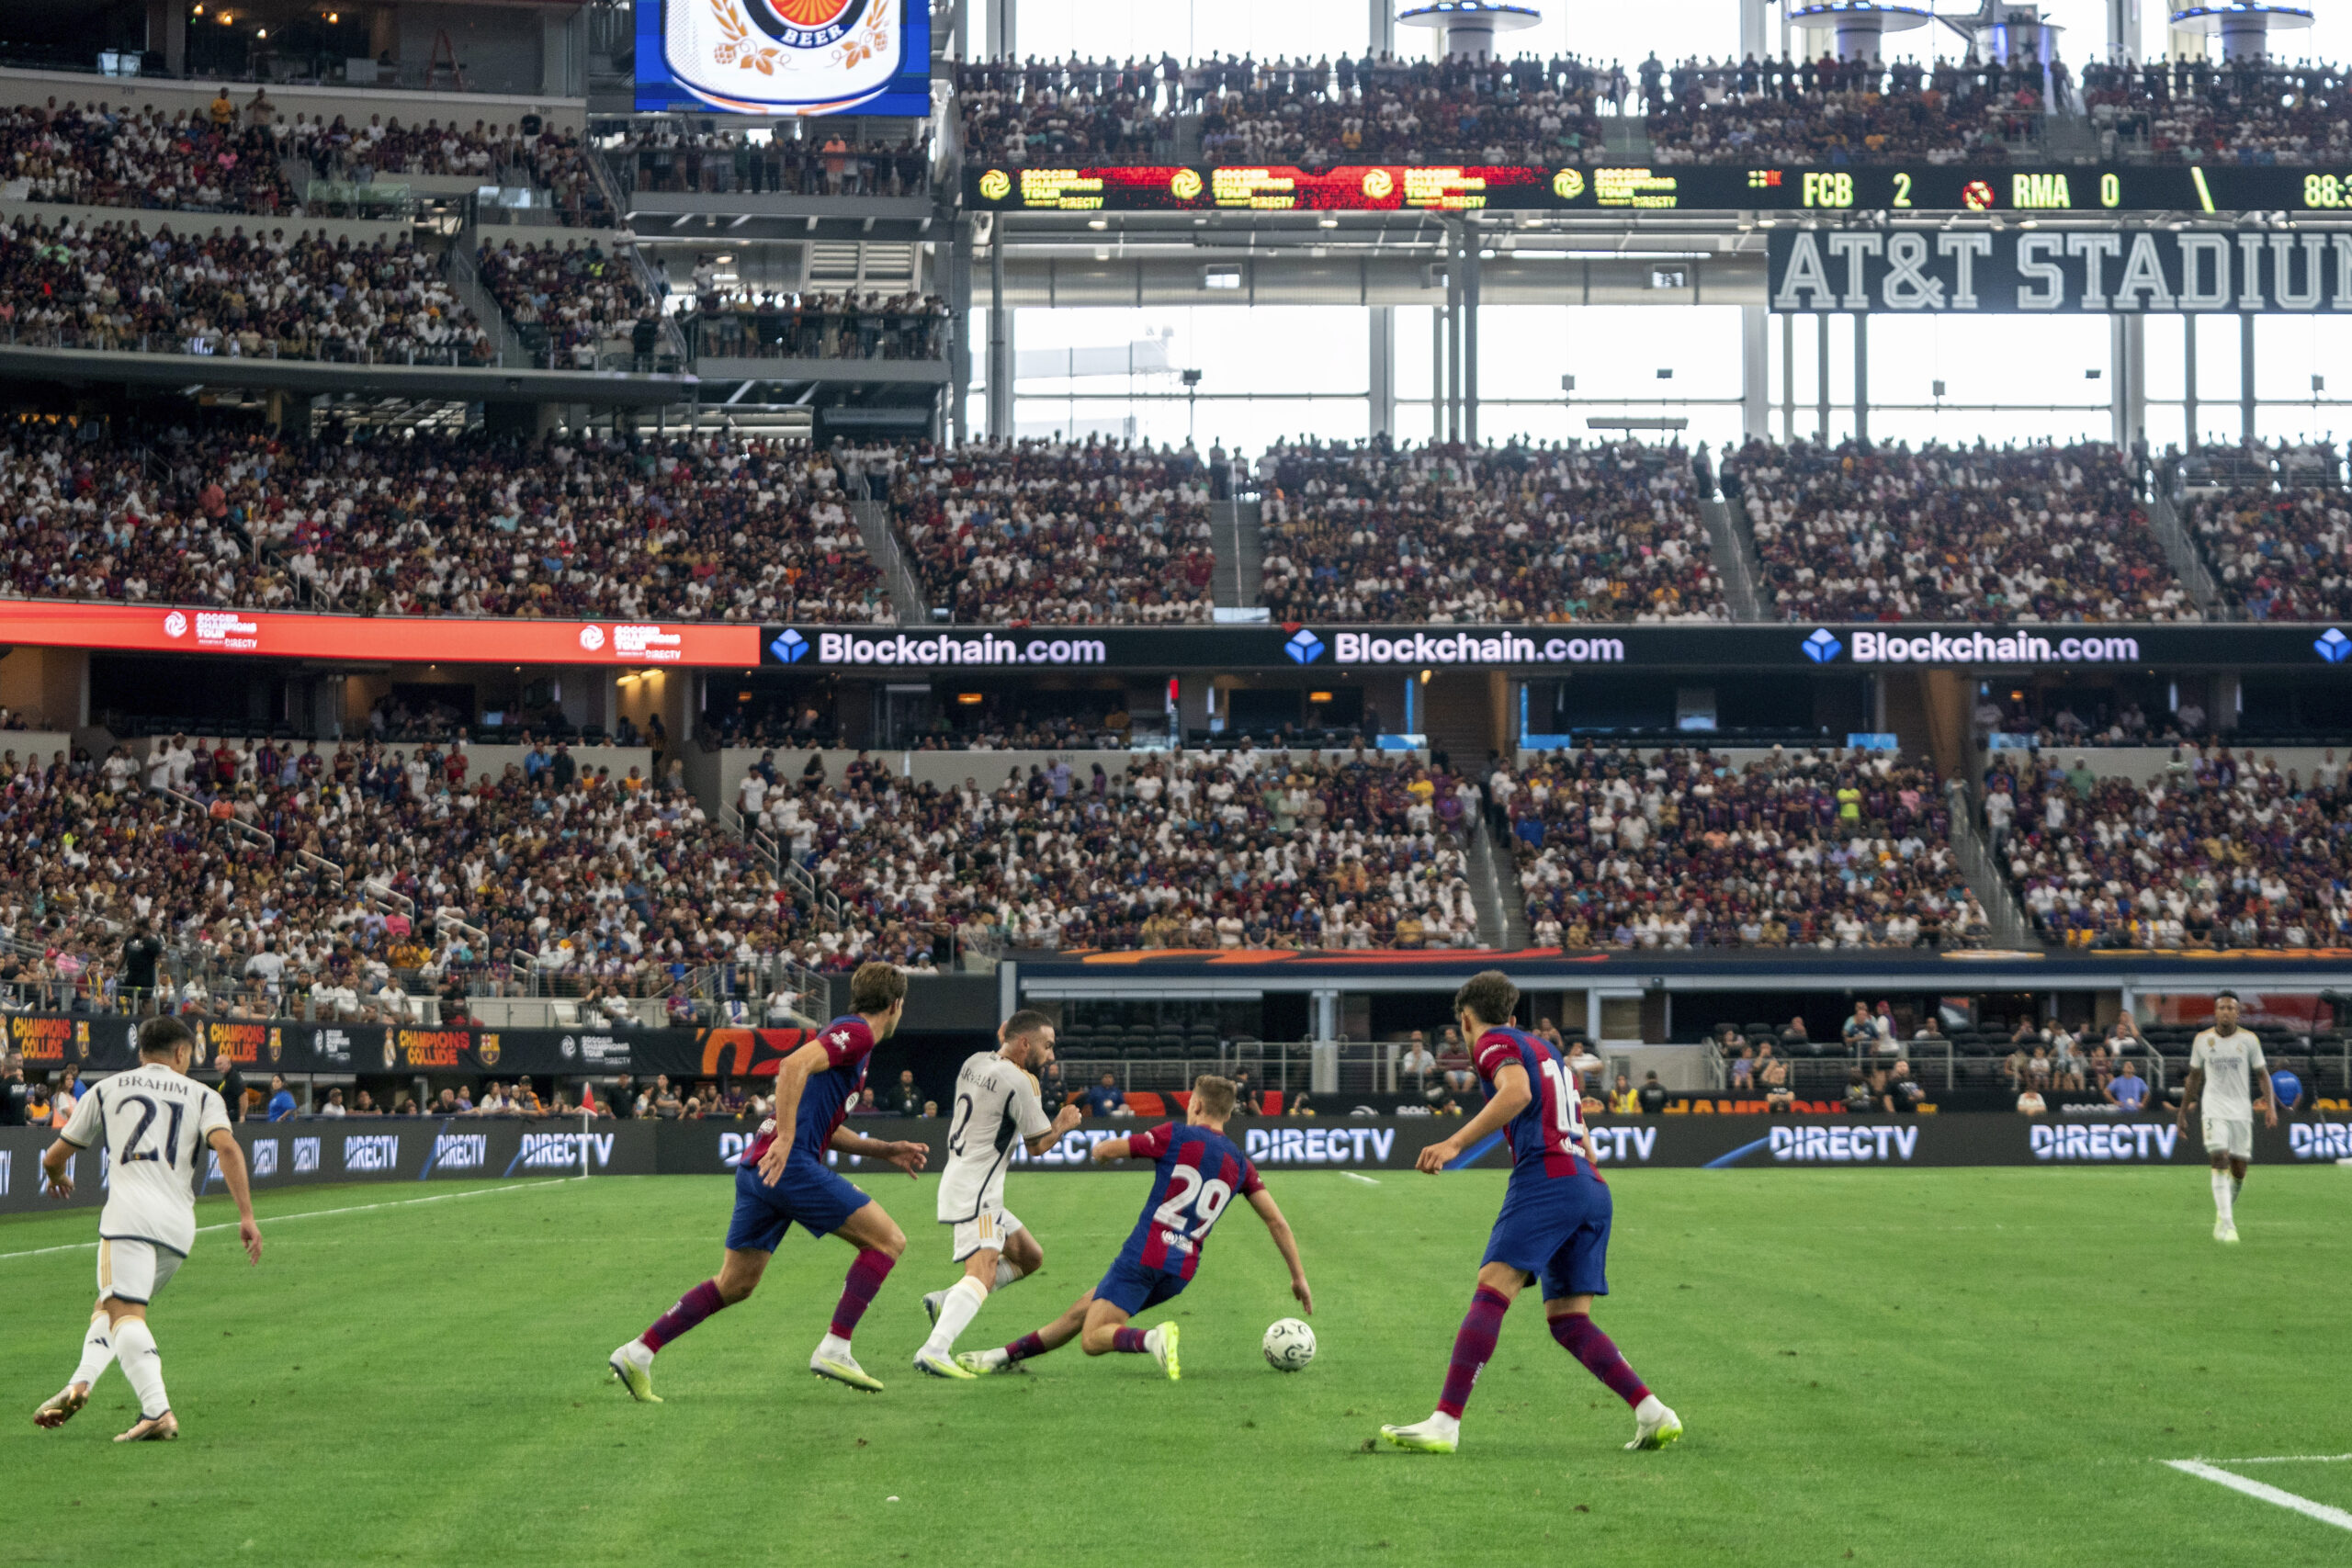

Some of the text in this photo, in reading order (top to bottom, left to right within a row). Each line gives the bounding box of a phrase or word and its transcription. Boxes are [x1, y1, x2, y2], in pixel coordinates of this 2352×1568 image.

[780, 24, 844, 47] BEER
[1021, 169, 1078, 180] SOCCER
[1212, 169, 1269, 180] SOCCER
[1404, 168, 1461, 179] SOCCER
[1594, 168, 1652, 179] SOCCER
[1022, 188, 1060, 199] TOUR
[1213, 188, 1252, 199] TOUR
[1405, 187, 1442, 198] TOUR
[1595, 187, 1634, 198] TOUR
[1803, 173, 1853, 208] FCB
[1893, 172, 1912, 208] 2
[2012, 174, 2071, 209] RMA
[2100, 173, 2120, 208] 0
[1058, 197, 1103, 209] DIRECTV
[1250, 196, 1295, 209] DIRECTV
[1442, 196, 1487, 209] DIRECTV
[1632, 196, 1677, 209] DIRECTV
[1774, 232, 1992, 310] AT&T
[197, 613, 239, 623] SOCCER
[197, 629, 225, 638] TOUR
[614, 626, 661, 636] SOCCER
[225, 638, 257, 649] DIRECTV
[819, 633, 1106, 663] Blockchain.com
[1335, 631, 1624, 662] Blockchain.com
[1852, 630, 2139, 661] Blockchain.com
[645, 649, 681, 660] DIRECTV
[13, 1016, 71, 1039] CHAMPIONS
[210, 1022, 266, 1043] CHAMPIONS
[22, 1038, 63, 1058] COLLIDE
[399, 1029, 470, 1049] CHAMPIONS
[408, 1047, 458, 1066] COLLIDE
[582, 1049, 604, 1057] TOUR
[119, 1076, 188, 1096] BRAHIM
[116, 1094, 185, 1170] 21
[2030, 1124, 2178, 1159] DIRECTV
[345, 1135, 399, 1169] DIRECTV
[435, 1134, 486, 1168] DIRECTV
[521, 1133, 614, 1168] DIRECTV
[1246, 1127, 1396, 1164] DIRECTV
[1770, 1125, 1918, 1160] DIRECTV
[254, 1139, 278, 1174] DIRECTV
[294, 1136, 321, 1171] DIRECTV
[1153, 1164, 1231, 1239] 29
